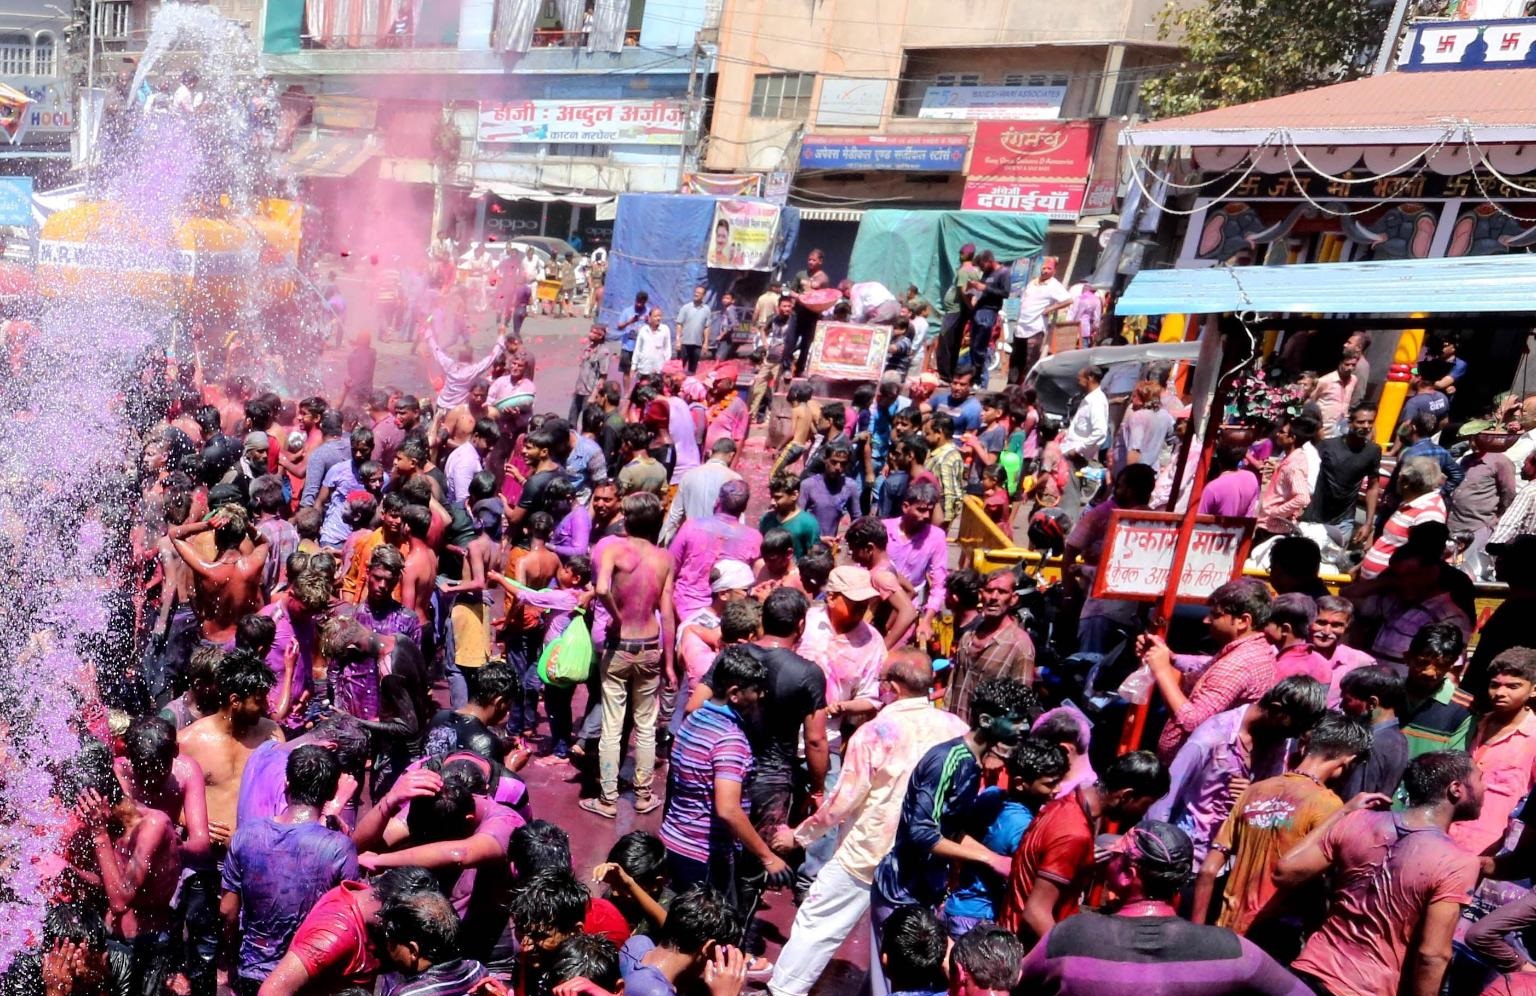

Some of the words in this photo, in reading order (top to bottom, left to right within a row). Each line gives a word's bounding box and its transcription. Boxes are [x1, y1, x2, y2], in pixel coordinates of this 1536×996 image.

[494, 102, 535, 122] हाजी
[556, 105, 612, 127] अब्दुल
[488, 218, 538, 230] oppo
[585, 227, 613, 236] opp
